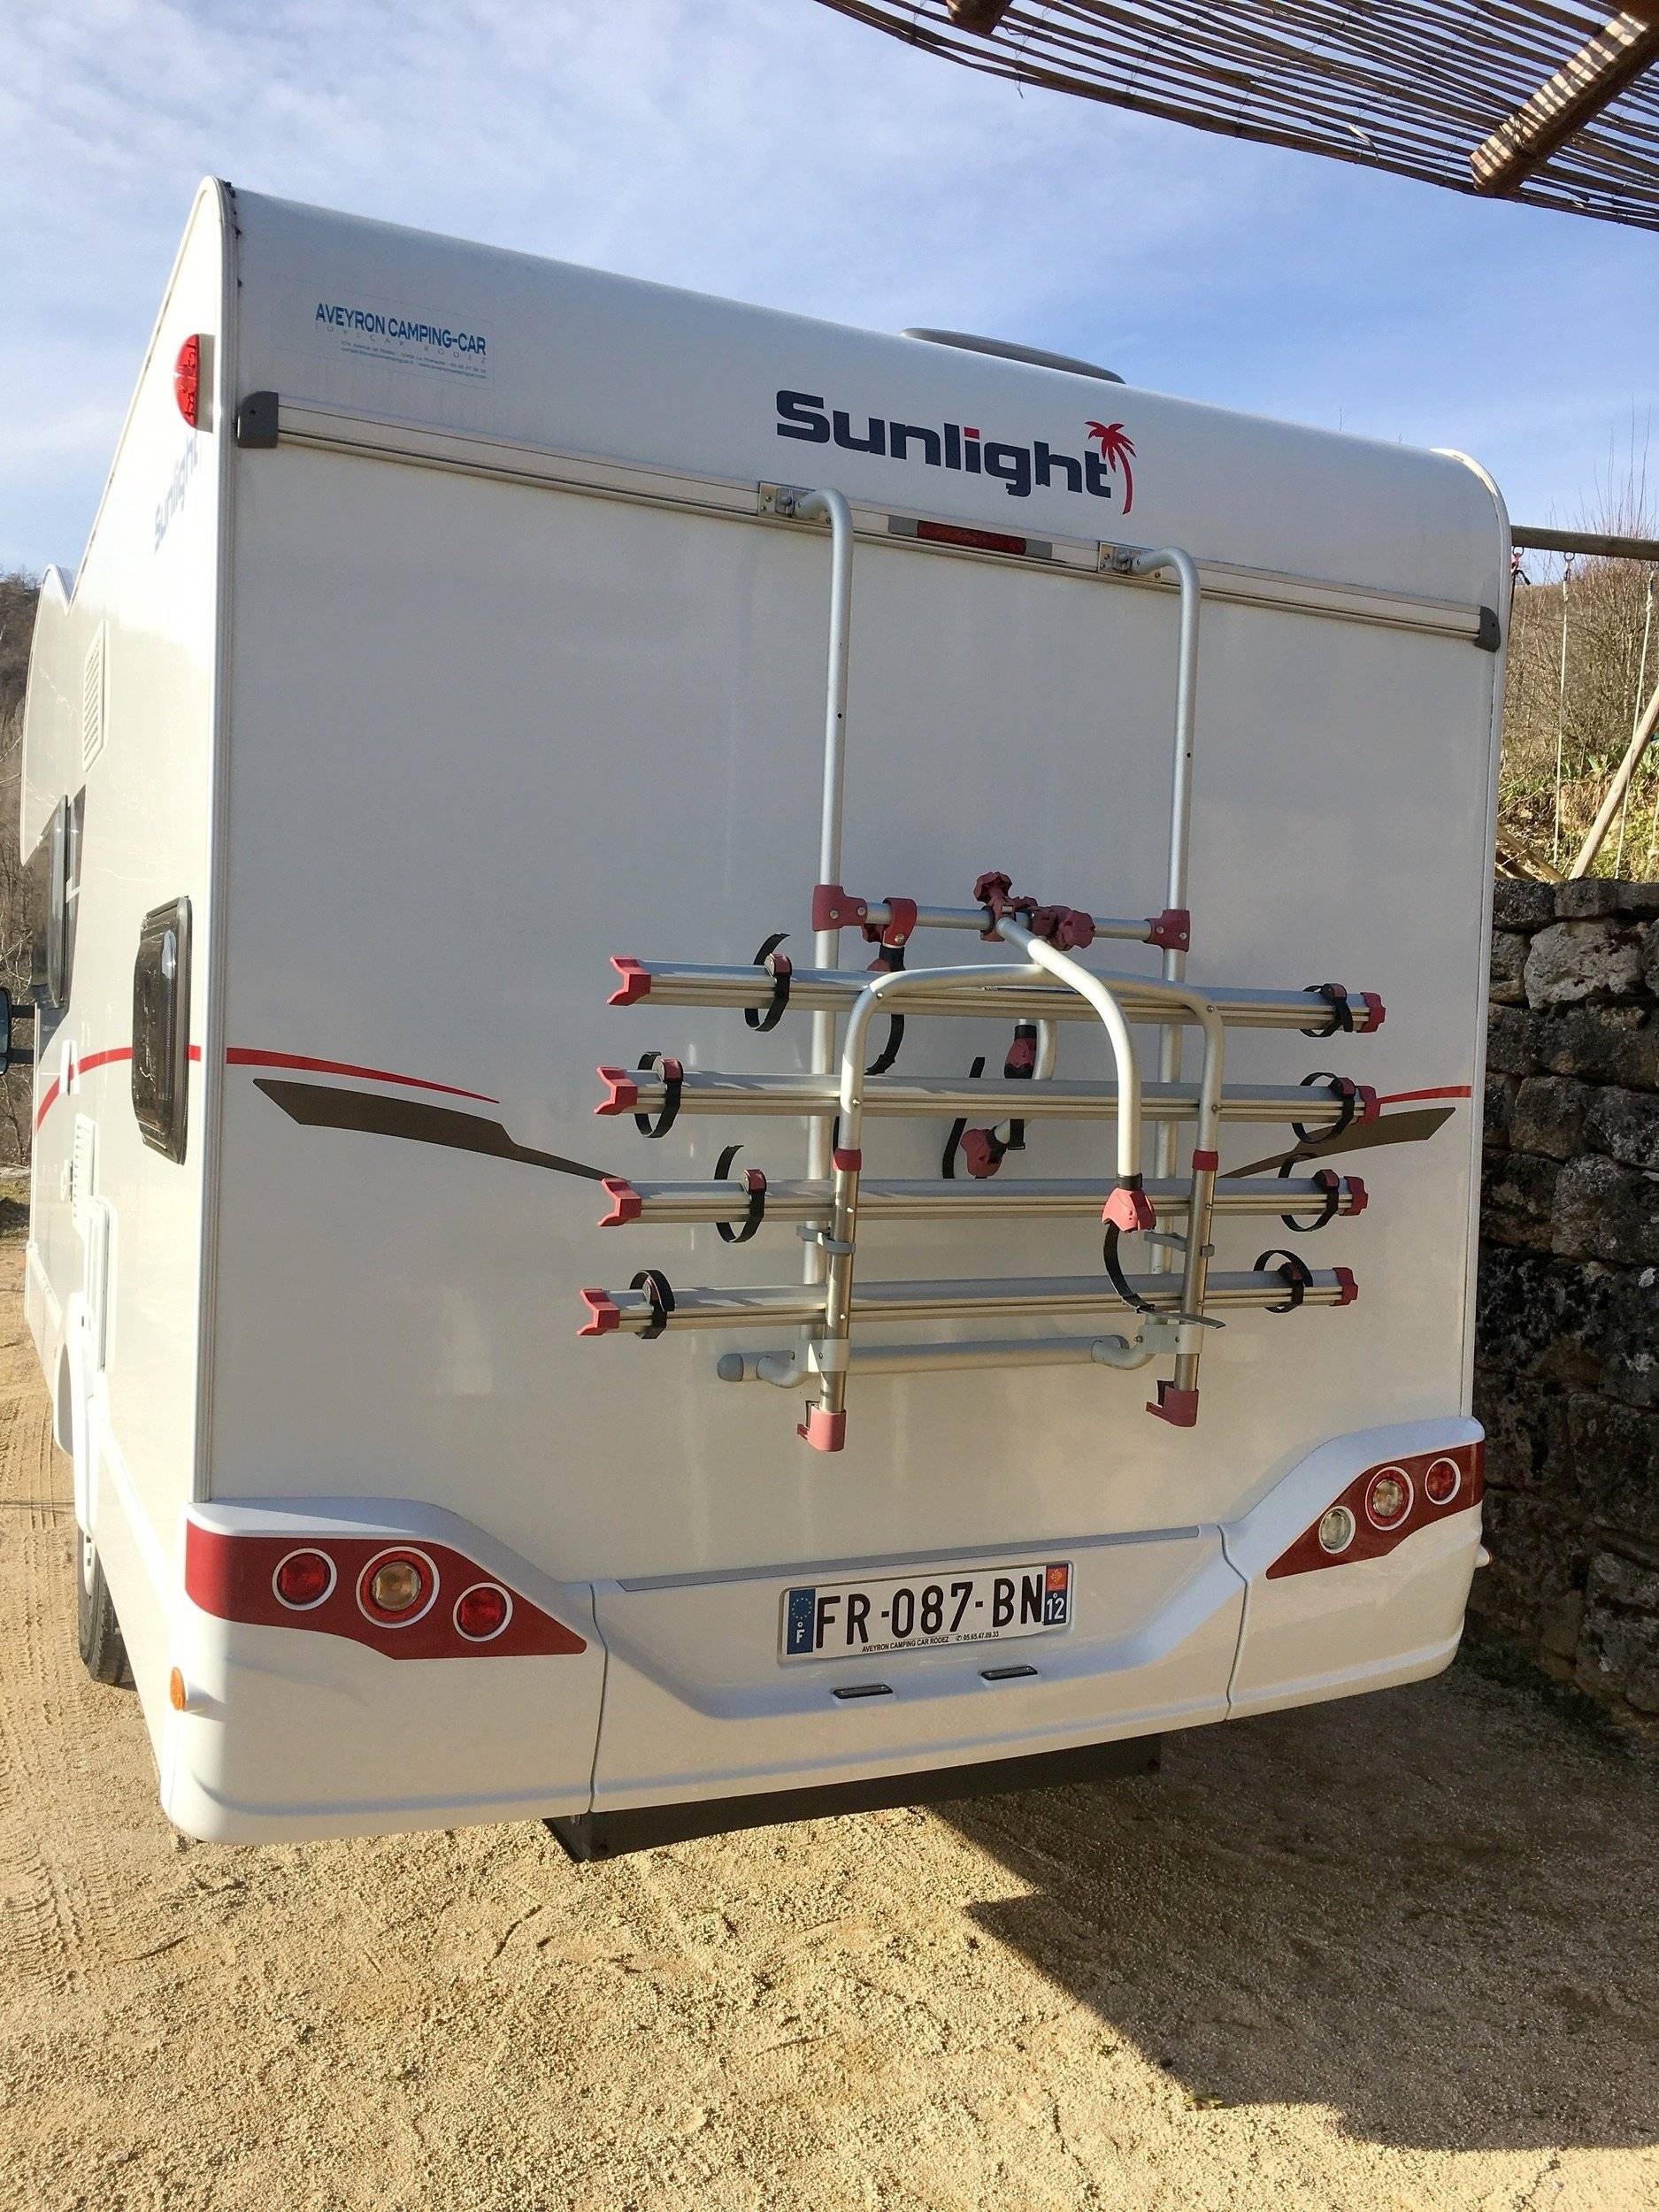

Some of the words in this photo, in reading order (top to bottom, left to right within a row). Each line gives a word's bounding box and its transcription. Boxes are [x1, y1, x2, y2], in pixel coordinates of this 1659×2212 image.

[316, 303, 385, 334] AVEYRON
[388, 318, 486, 355] CAMPING-CAR
[776, 389, 1111, 498] Sunlight
[816, 1573, 1043, 1648] FR-087-BN
[1047, 1597, 1065, 1621] 12
[795, 1629, 805, 1644] F
[861, 1643, 889, 1653] AVEYRON
[890, 1639, 916, 1648] CAMPING
[917, 1638, 929, 1647] CAR
